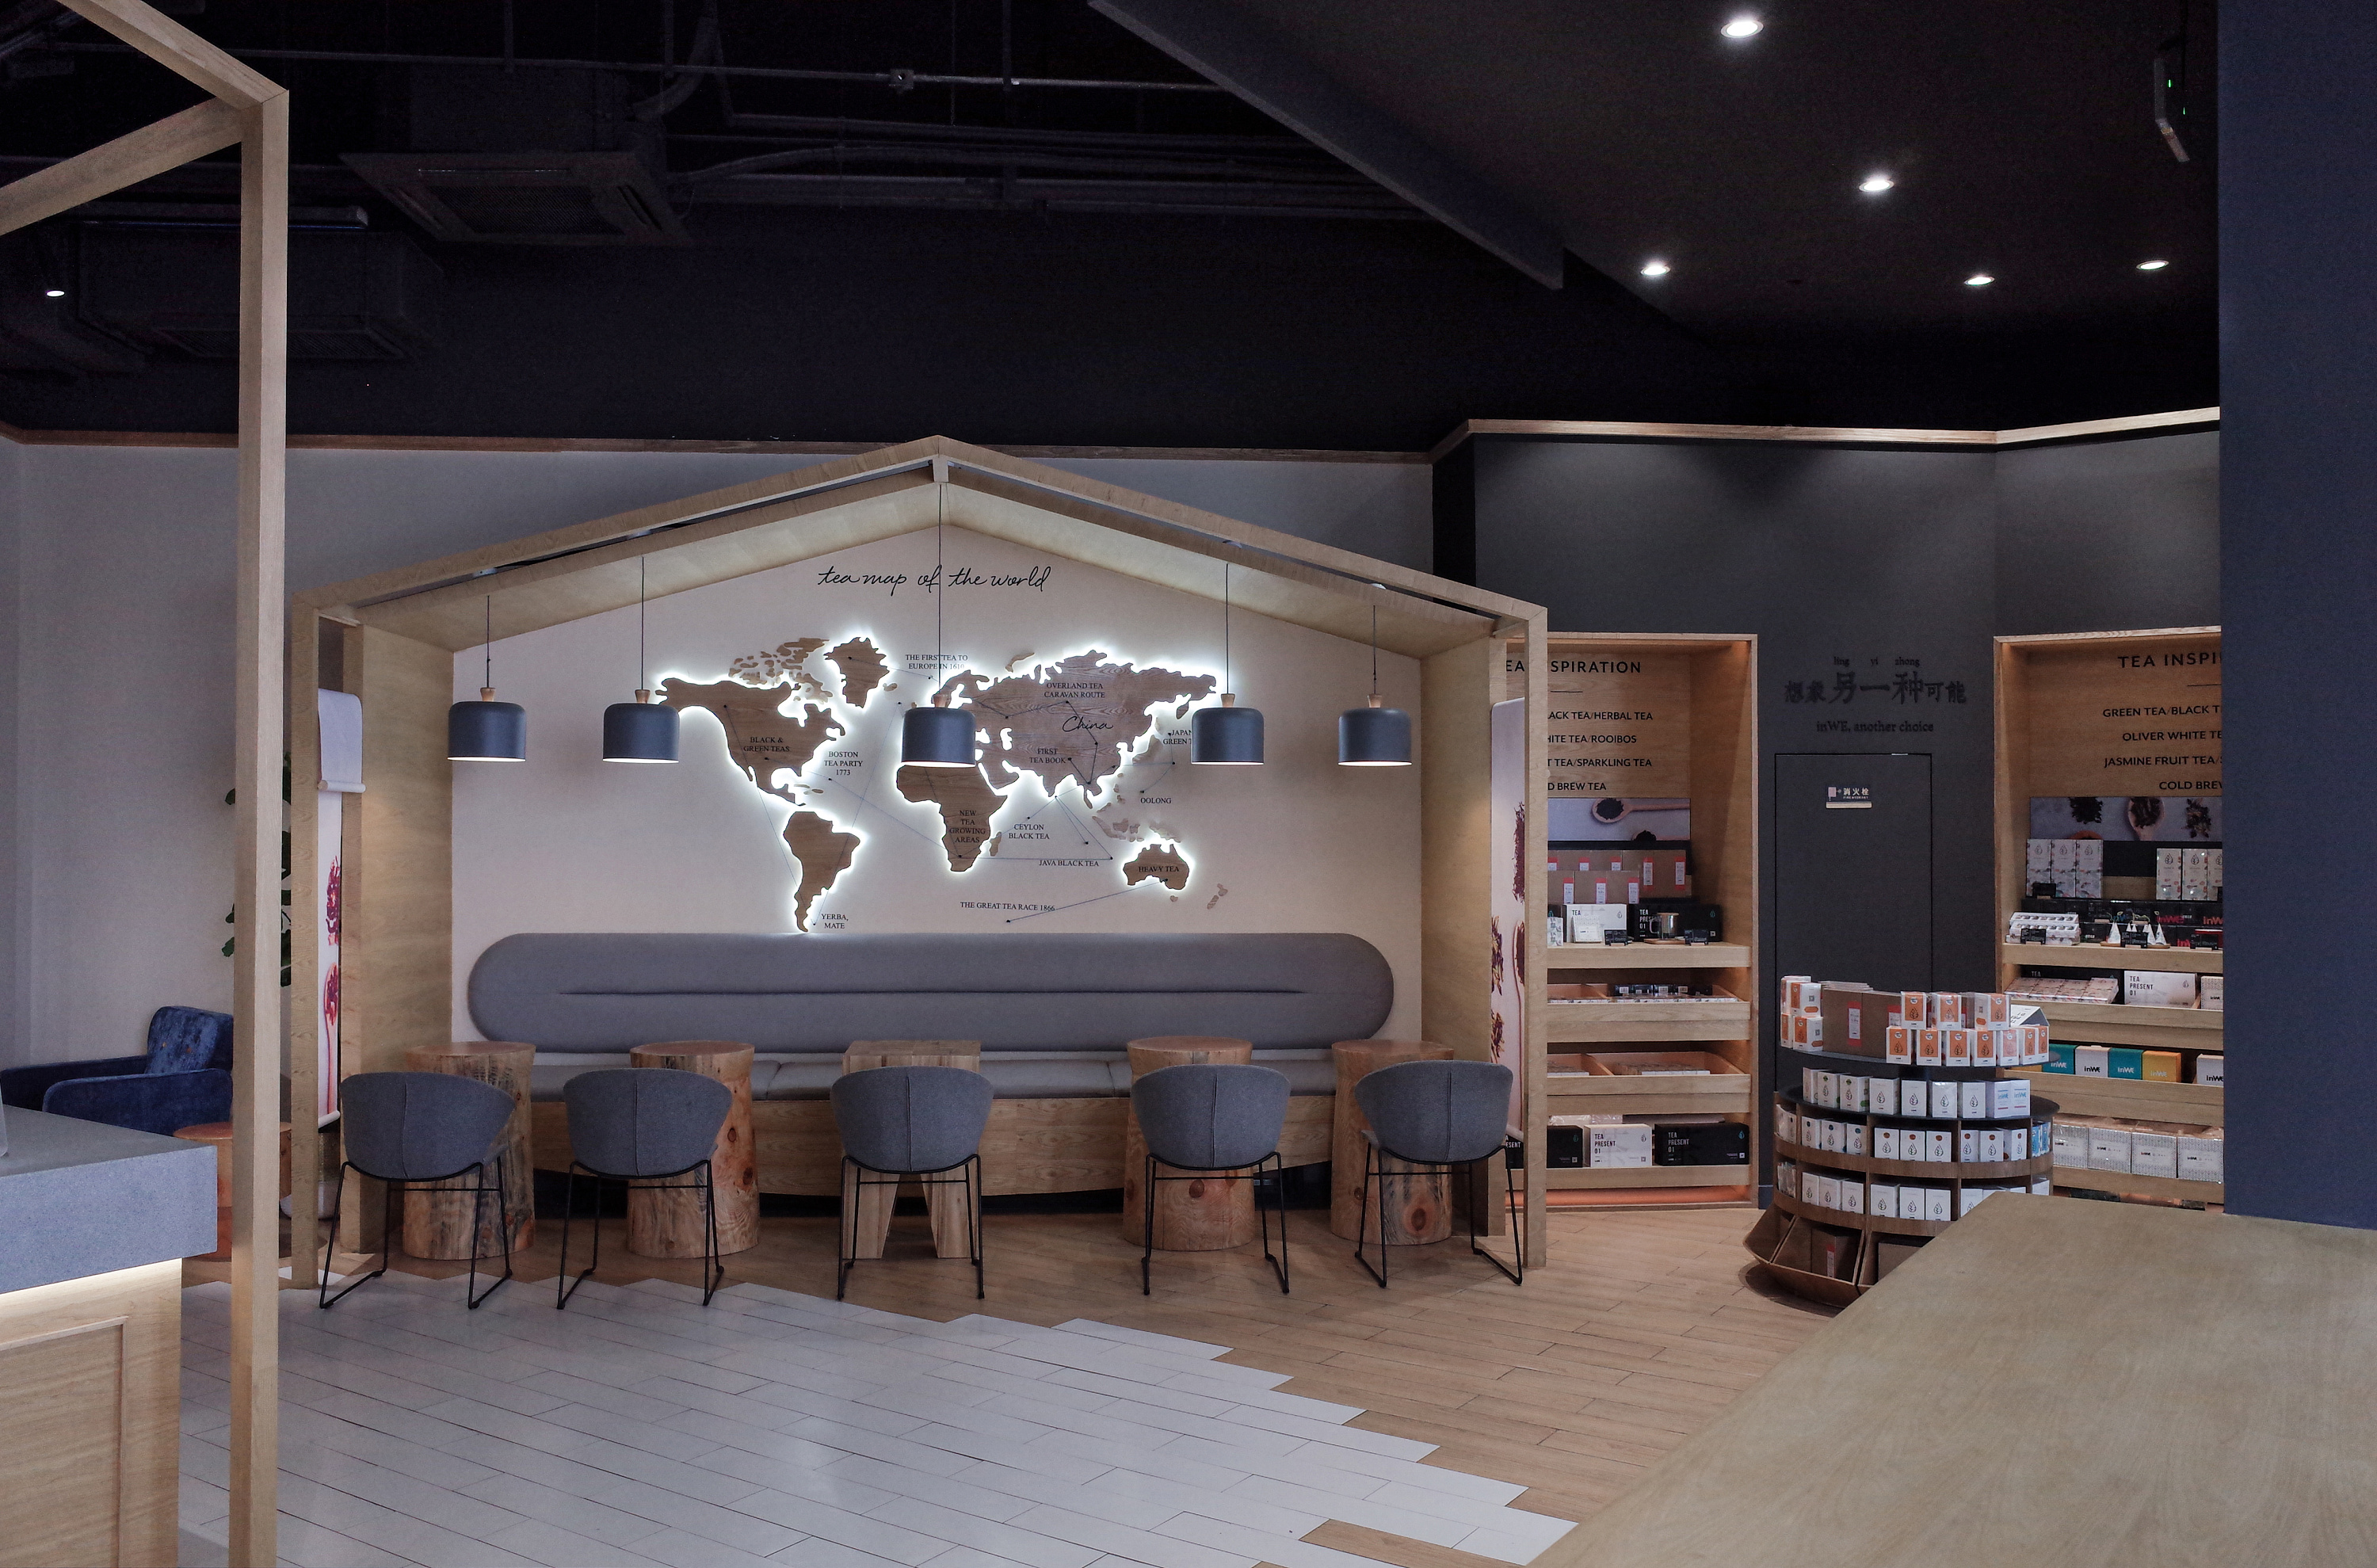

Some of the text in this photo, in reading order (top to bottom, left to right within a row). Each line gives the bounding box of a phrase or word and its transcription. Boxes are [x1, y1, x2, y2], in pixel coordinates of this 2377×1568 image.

[818, 564, 1051, 597] tea map of the world
[1833, 656, 1920, 667] ling yi zhong
[2118, 652, 2222, 668] TEA INSPI
[1571, 712, 1631, 720] TEA/HERBAL
[1634, 712, 1654, 720] TEA
[2102, 708, 2141, 717] GREEN
[2144, 705, 2210, 715] TEA/BLACK
[1062, 715, 1114, 733] China
[1854, 720, 1896, 732] another
[1899, 720, 1933, 732] choice
[1569, 734, 1637, 743] TEA/ROOIBOS
[2122, 731, 2165, 741] OLIVER
[2167, 731, 2206, 740] WHITE
[1555, 758, 1631, 767] TEA/SPARKLING
[1633, 758, 1653, 767] TEA
[2104, 757, 2152, 768] JASMINE
[2154, 756, 2189, 765] FRUIT
[2158, 780, 2192, 790] COLD
[1843, 787, 1869, 795] 消火栓
